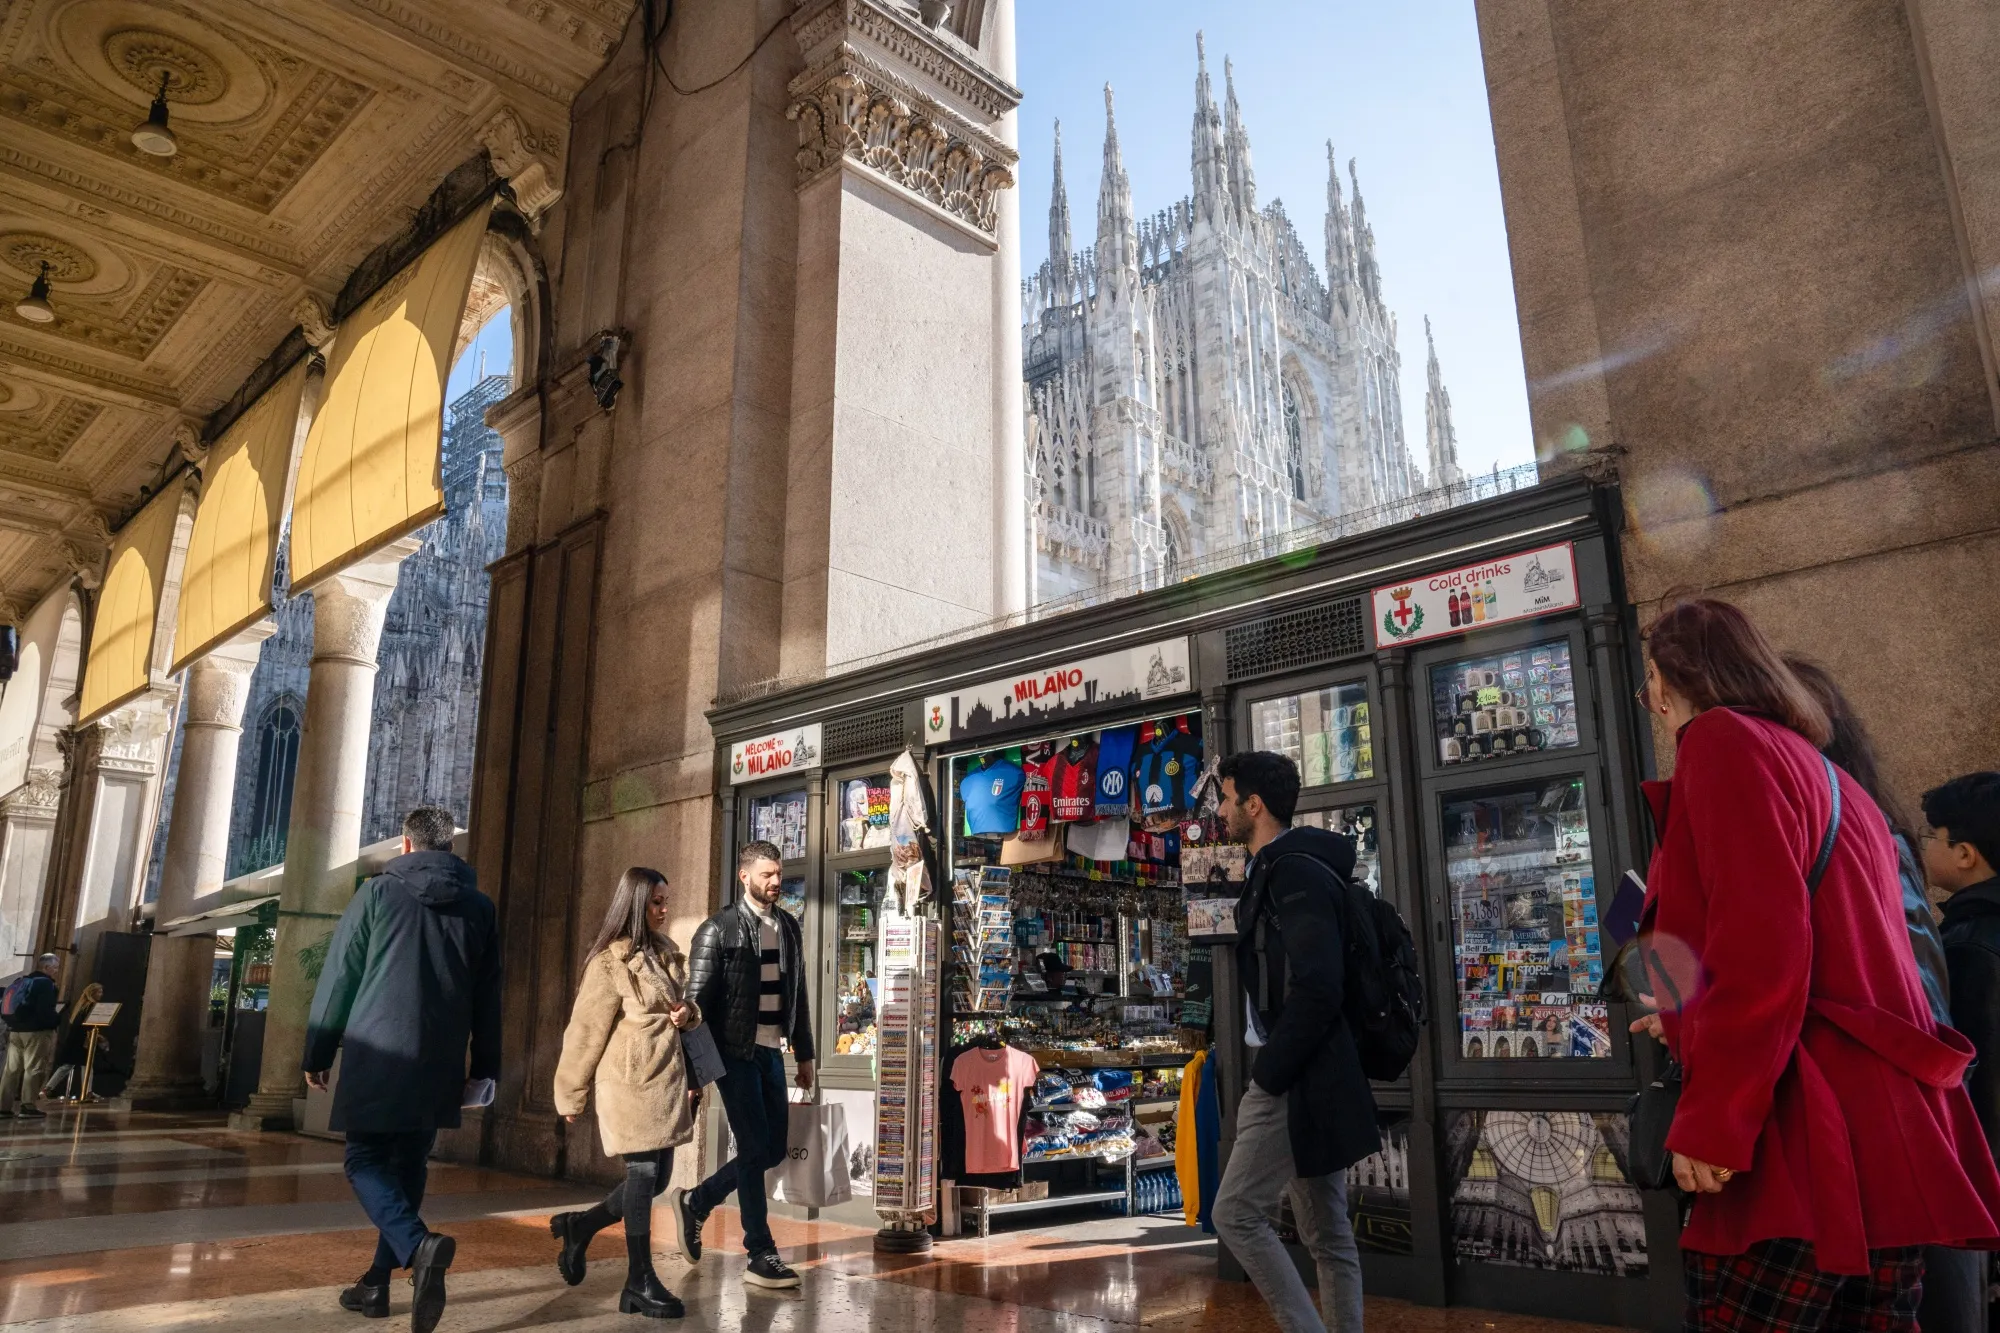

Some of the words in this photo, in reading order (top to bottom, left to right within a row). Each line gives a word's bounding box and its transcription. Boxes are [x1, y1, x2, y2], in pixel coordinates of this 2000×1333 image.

[1428, 573, 1461, 592] Cold
[1465, 563, 1511, 582] drinks
[1013, 668, 1084, 703] MILANO
[744, 737, 776, 756] WELCOME
[747, 749, 792, 777] MILANO
[1052, 796, 1090, 808] Emirates
[1065, 807, 1084, 816] BETTER
